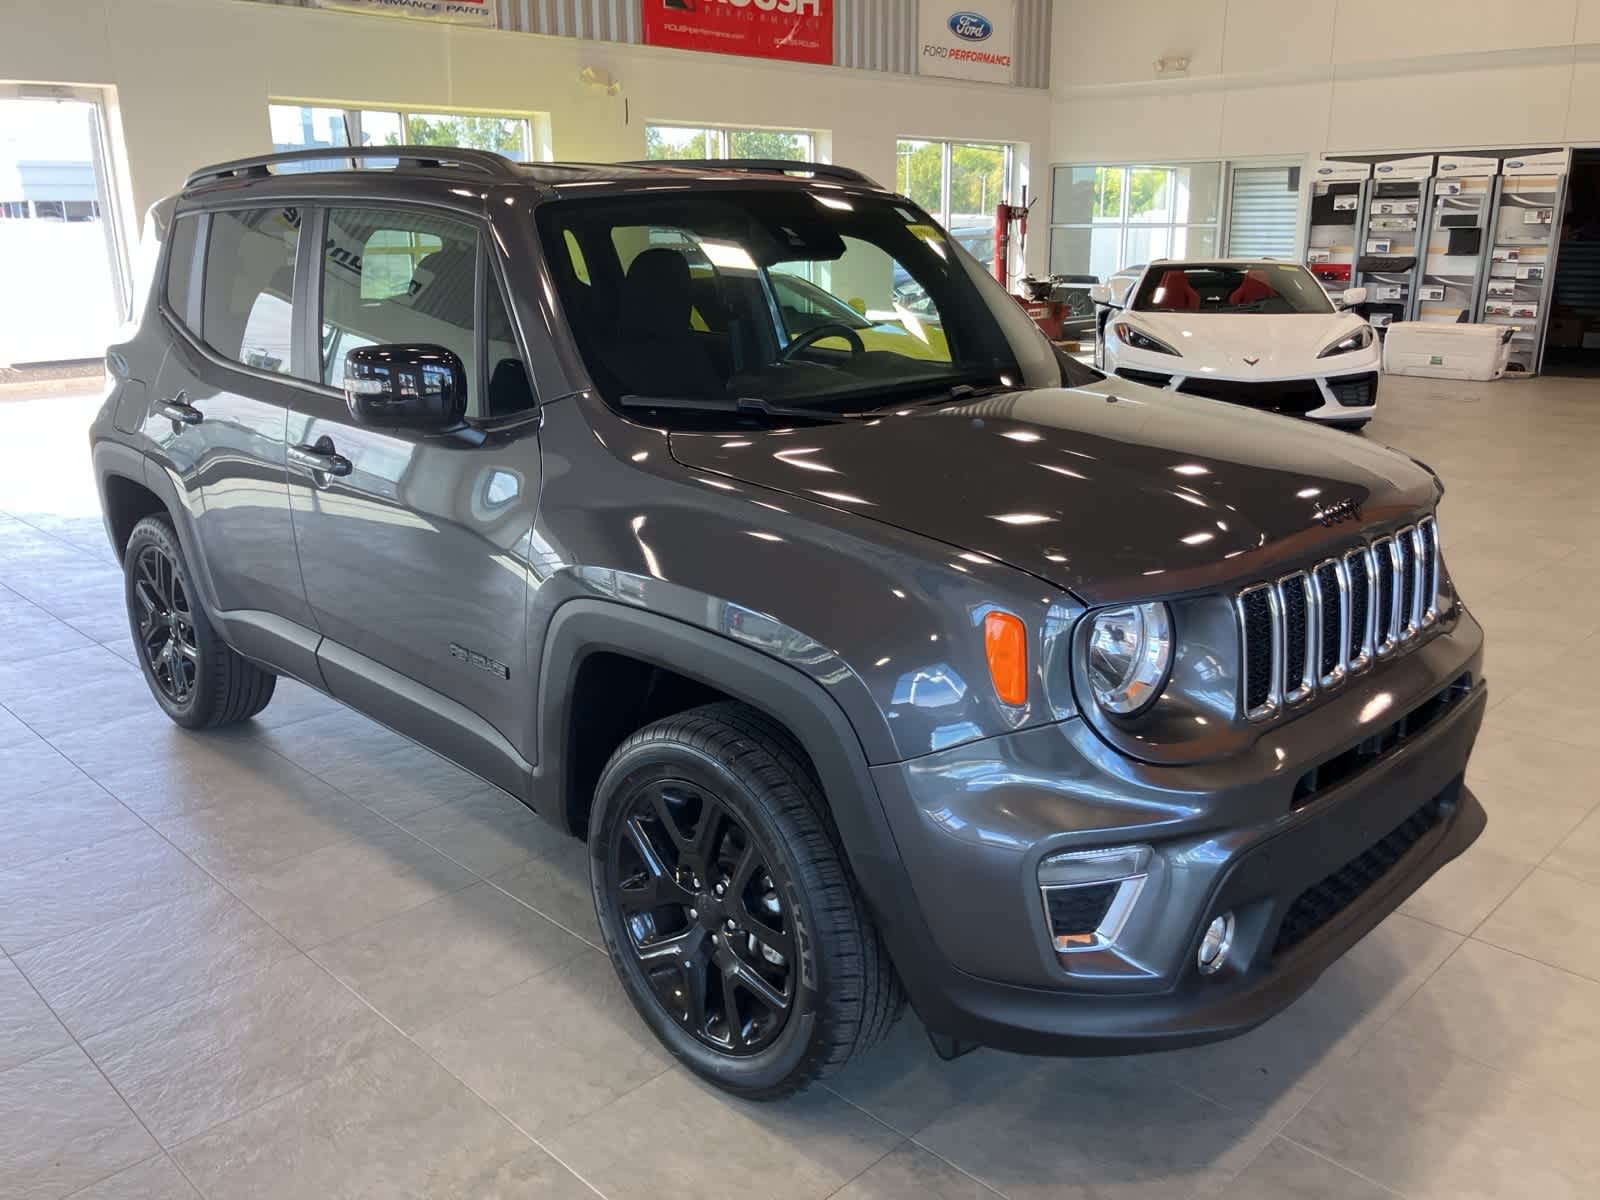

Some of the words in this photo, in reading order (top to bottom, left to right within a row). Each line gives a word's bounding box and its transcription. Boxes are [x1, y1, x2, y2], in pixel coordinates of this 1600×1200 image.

[446, 5, 489, 15] PARTS
[956, 16, 984, 37] Ford
[923, 45, 948, 58] FORD
[949, 48, 1011, 67] PERFORMANCE
